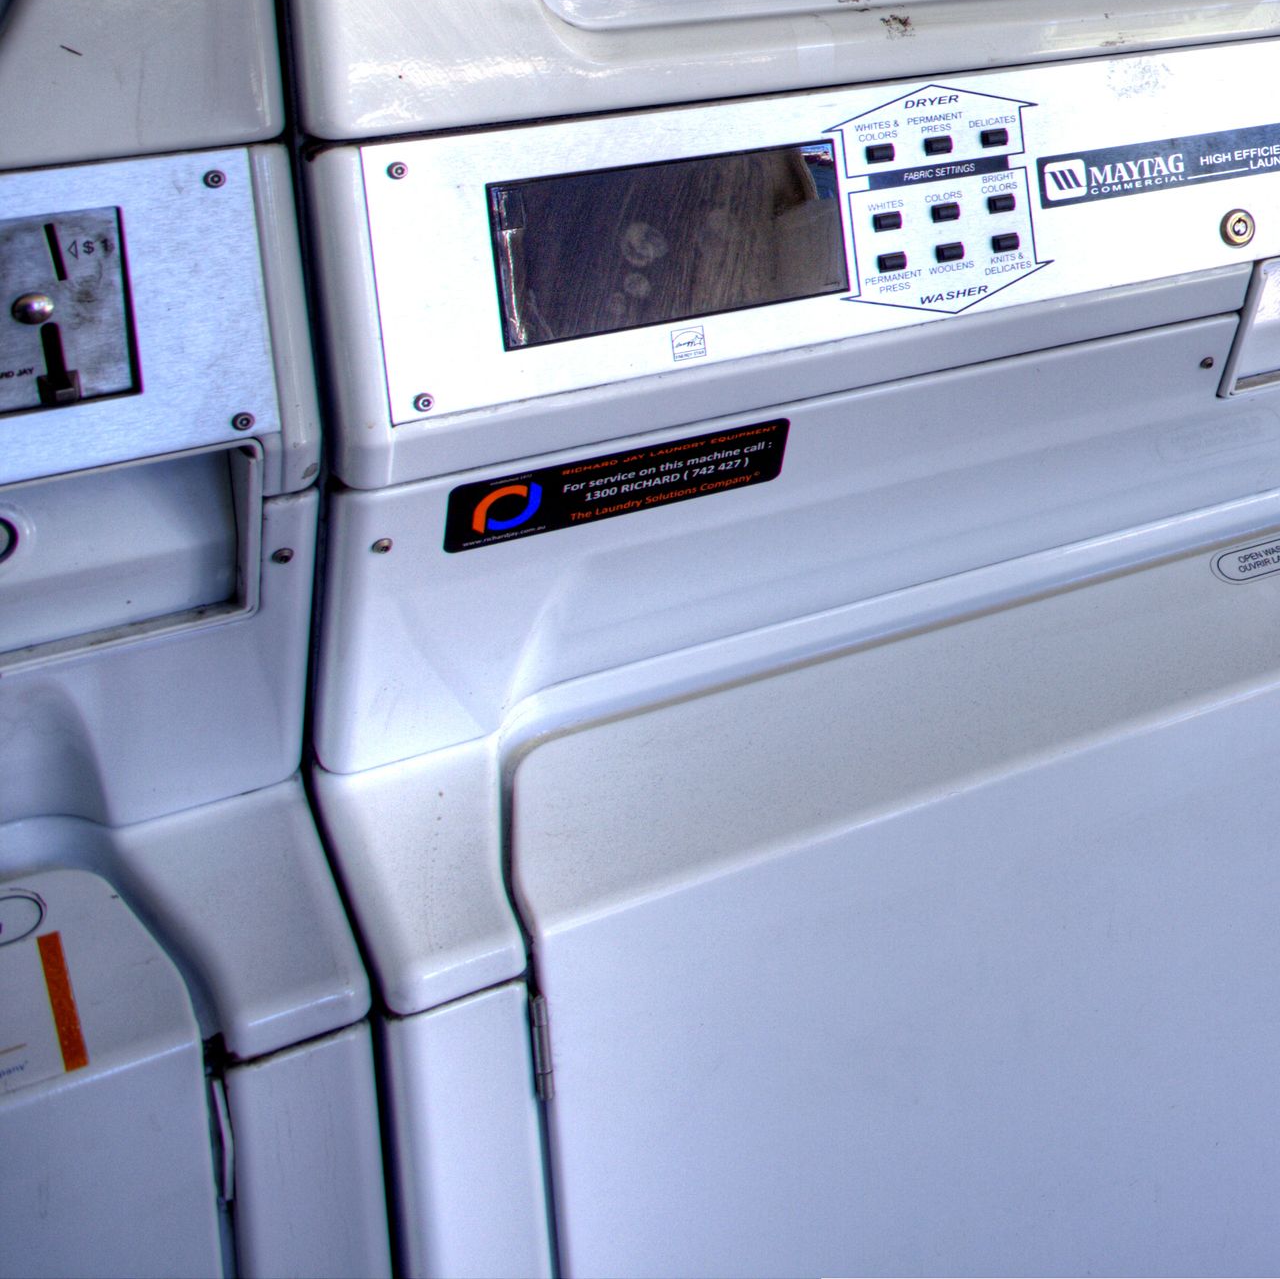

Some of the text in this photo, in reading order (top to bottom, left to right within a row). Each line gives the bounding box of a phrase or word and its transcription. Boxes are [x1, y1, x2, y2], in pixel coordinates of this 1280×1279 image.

[904, 94, 959, 109] DRYER
[907, 111, 963, 126] PERMANENT
[968, 115, 1016, 129] DELICATES
[855, 121, 890, 132] WHITES
[921, 123, 952, 134] PRESS
[858, 130, 898, 143] COLORS
[1199, 153, 1232, 166] HIGH
[903, 163, 975, 181] FABRIC SETTINGS
[1090, 153, 1184, 187] MAYTAG
[981, 172, 1014, 184] BRIGHT
[1090, 174, 1185, 195] COMMERCIAL
[981, 181, 1018, 195] COLORS
[924, 190, 963, 203] COLORS
[868, 200, 904, 212] WHITES
[990, 253, 1016, 265] KNITS
[928, 260, 975, 275] WOOLENS
[984, 260, 1032, 276] DELICATES
[865, 269, 922, 286] PERMANENT
[879, 282, 911, 294] PRESS
[919, 285, 988, 305] WASHER
[562, 425, 778, 476] RICHARD JAY LAUNDRY EQUIPMENT
[562, 440, 766, 493] For service on this machine call
[584, 459, 742, 502] 1300 RICHARD 742 427
[570, 509, 592, 522] The
[595, 498, 642, 517] Laundry
[645, 486, 697, 506] Solutions
[1238, 550, 1264, 563] OPEN
[1238, 558, 1271, 573] OUVRIR
